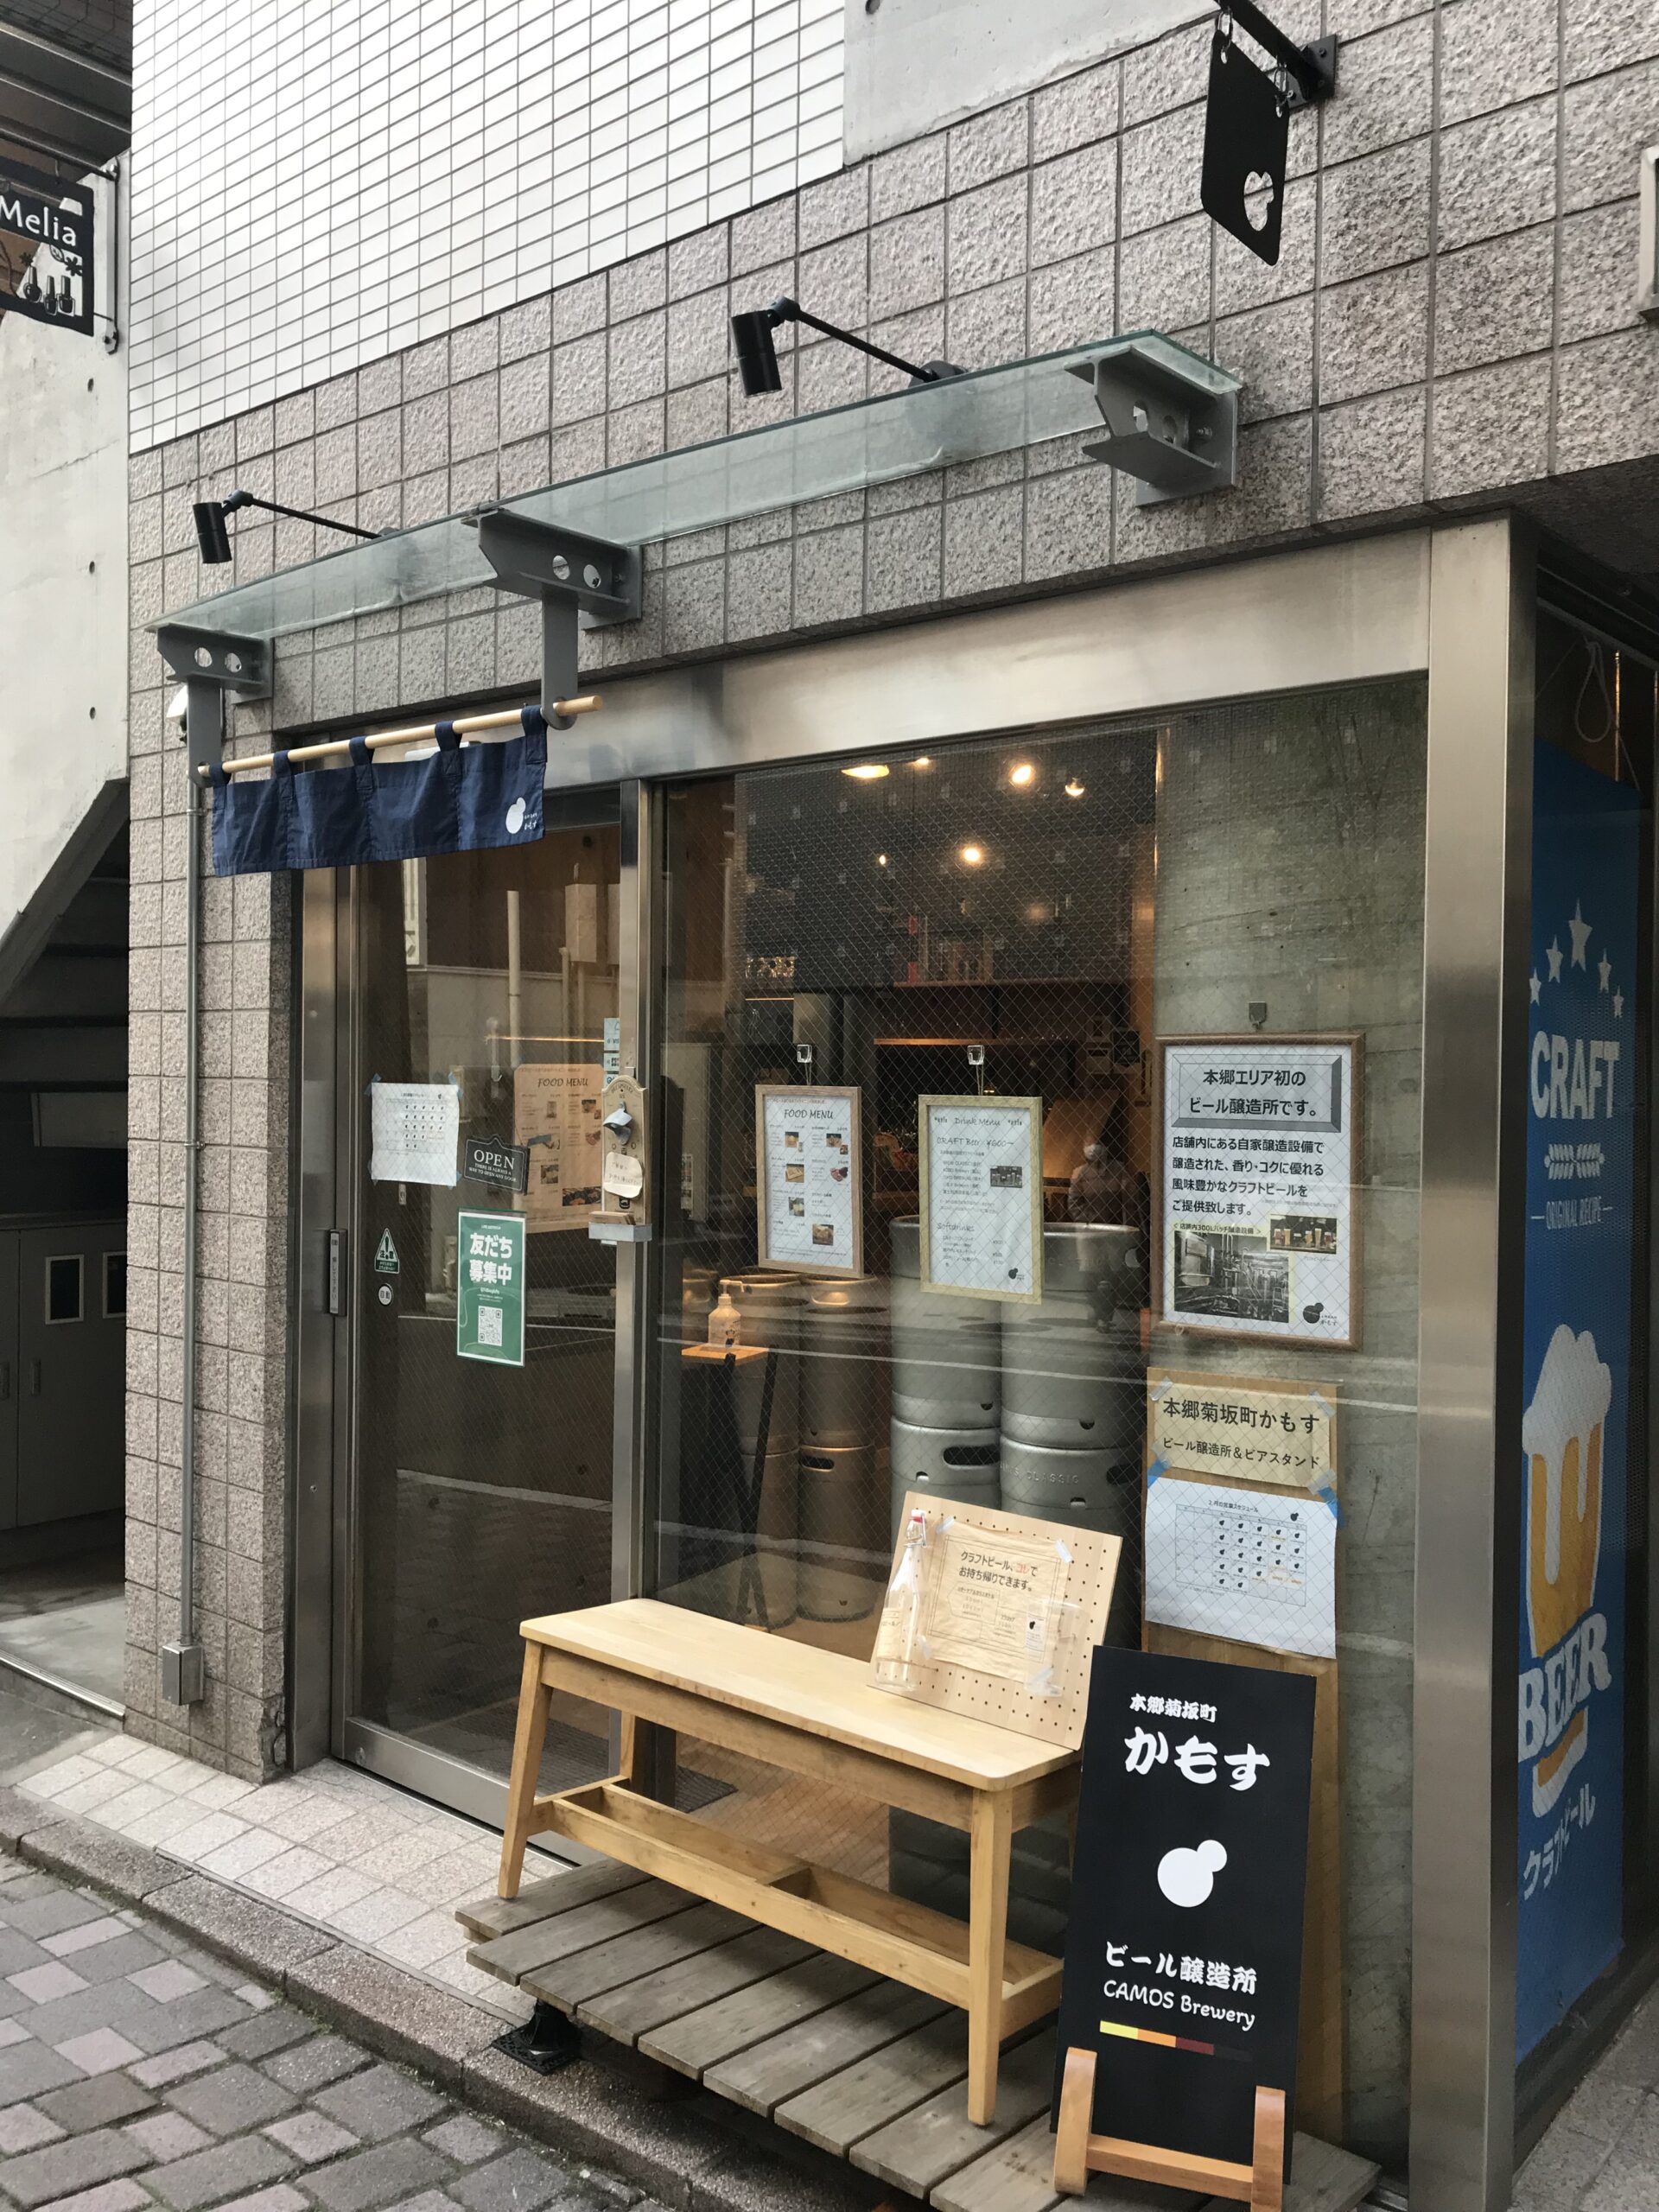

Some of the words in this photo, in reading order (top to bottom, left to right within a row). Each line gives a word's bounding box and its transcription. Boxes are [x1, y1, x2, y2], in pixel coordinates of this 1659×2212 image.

[0, 195, 77, 247] Melia
[537, 1077, 563, 1088] FOOD
[565, 1077, 588, 1088] MENU
[1202, 1069, 1306, 1086] 本郷エリア初の
[1530, 1030, 1621, 1120] CRAFT
[784, 1109, 808, 1119] FOOD
[809, 1109, 834, 1120] MENU
[1189, 1096, 1317, 1116] ビール醸造所です。
[937, 1136, 963, 1145] CRAFT
[1172, 1135, 1325, 1154] 店舗内にある自家醸造設備で
[474, 1149, 515, 1170] OPEN
[1172, 1157, 1325, 1177] 醸造された、香り・コクに優れる
[1172, 1178, 1308, 1198] 風味豊かなクラフトビールを
[1172, 1198, 1252, 1216] ご提供致します。
[469, 1232, 513, 1259] 友だち
[469, 1259, 512, 1286] 募集中
[1163, 1397, 1320, 1434] 本郷菊坂町かもす
[1517, 1612, 1612, 1764] BEER
[1128, 1693, 1217, 1723] 本郷菊坂町
[1123, 1726, 1271, 1791] かもす
[1105, 1941, 1258, 1995] ビール醸造所
[1103, 1979, 1175, 2009] CAMOS
[1180, 1994, 1255, 2031] Brewery
